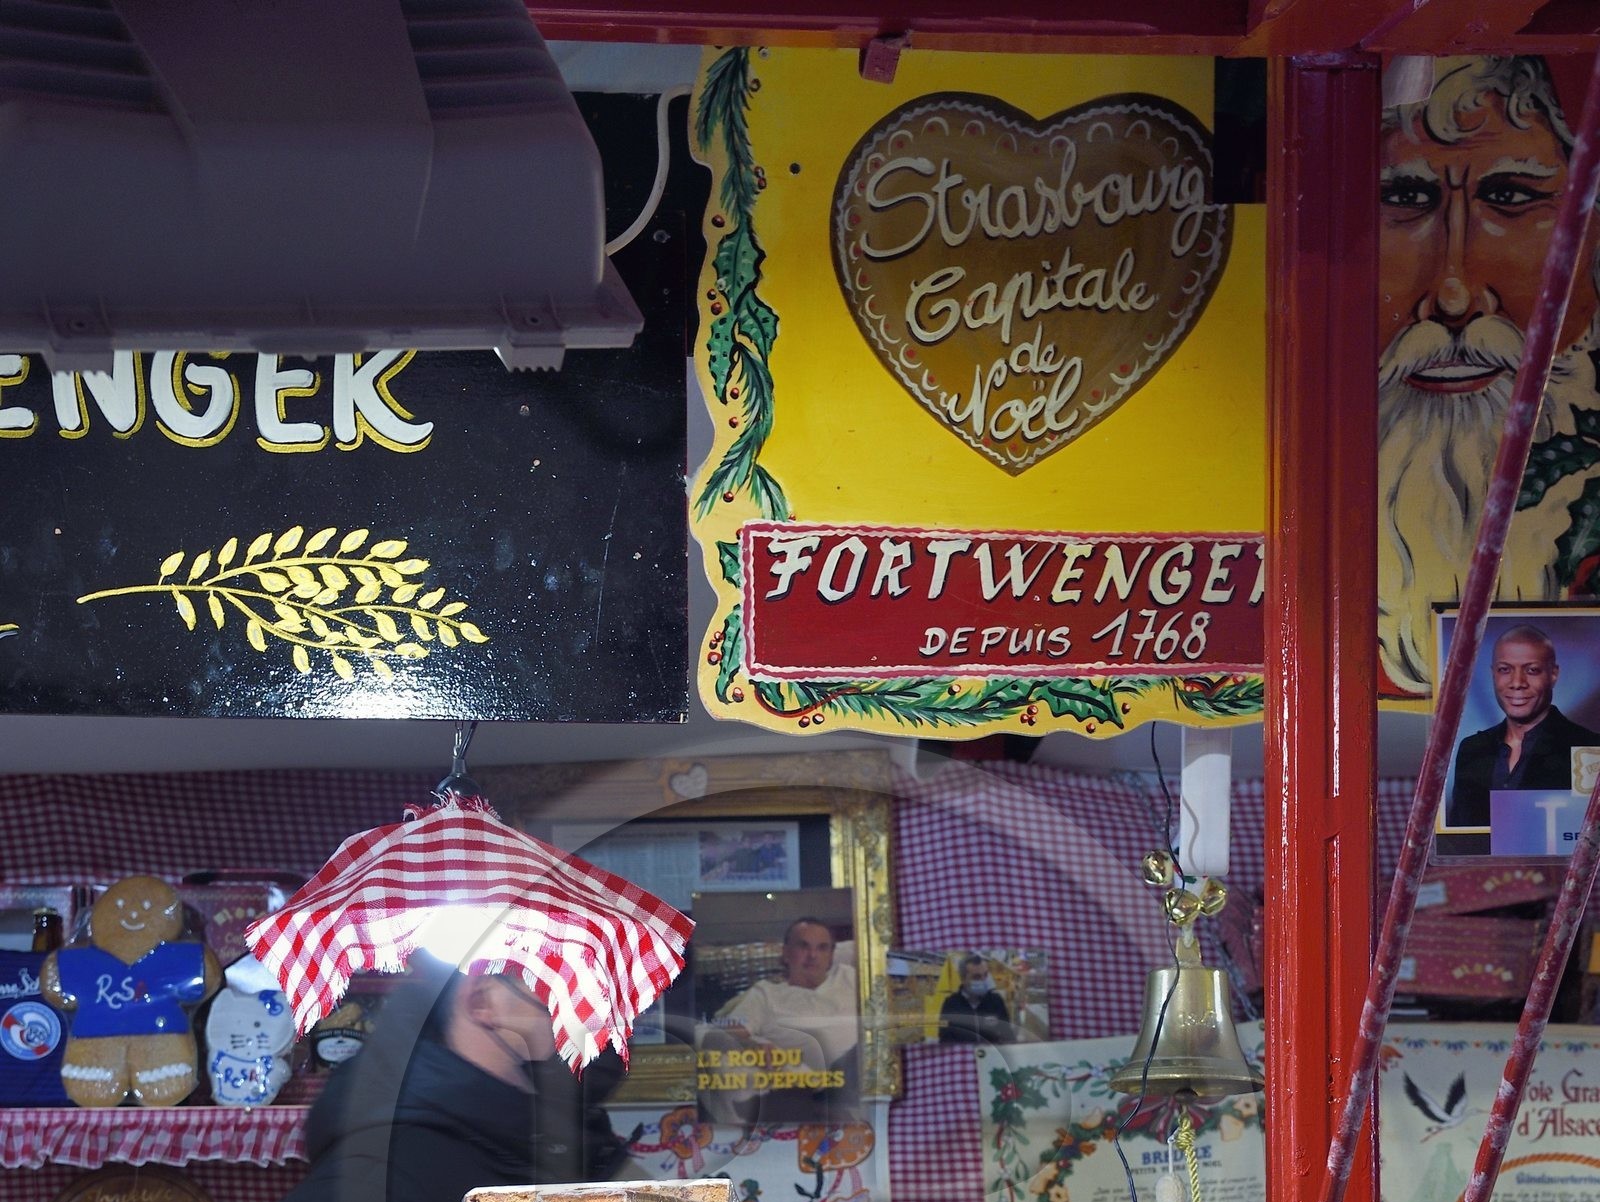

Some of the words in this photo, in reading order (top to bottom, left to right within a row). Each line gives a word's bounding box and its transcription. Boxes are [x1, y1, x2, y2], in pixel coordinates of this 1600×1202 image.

[862, 144, 1208, 260] Strasbourg
[905, 248, 1156, 344] Capitale
[1010, 323, 1064, 376] de
[940, 357, 1083, 442] Noël
[918, 624, 1073, 658] DEPUIS
[1090, 608, 1213, 661] 1768
[698, 1050, 722, 1068] LE
[727, 1049, 767, 1067] ROI
[771, 1048, 802, 1066] DU
[698, 1072, 749, 1090] PAIN
[753, 1066, 846, 1089] D'ÉPICES
[1522, 1070, 1553, 1102] oie
